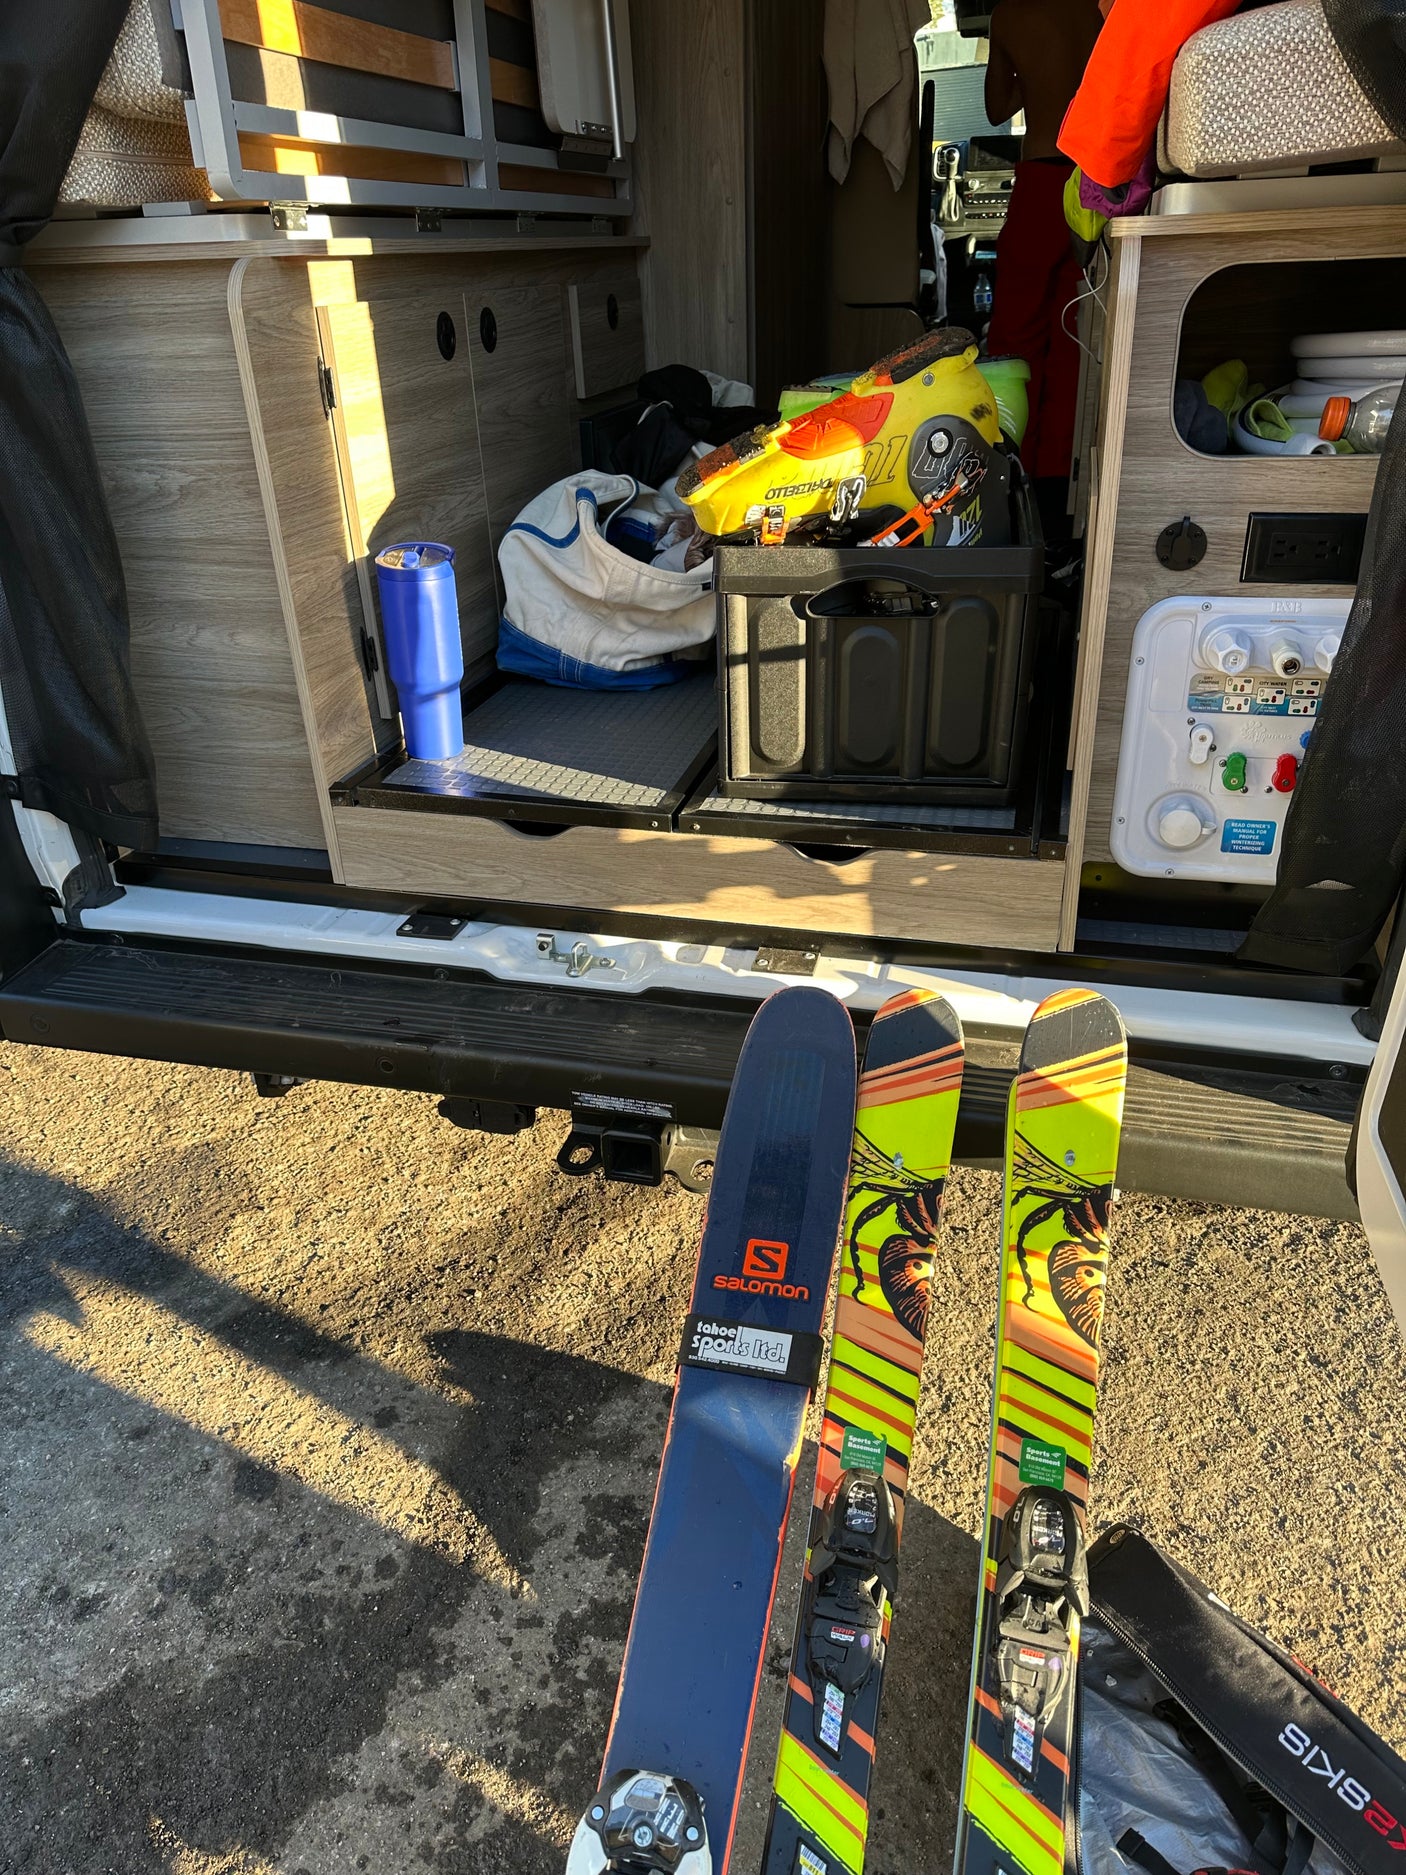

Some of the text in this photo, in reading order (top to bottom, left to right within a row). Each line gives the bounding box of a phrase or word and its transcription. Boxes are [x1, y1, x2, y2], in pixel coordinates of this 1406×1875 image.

[764, 477, 833, 500] DALBELLO
[696, 1320, 737, 1338] tahoe
[691, 1326, 785, 1364] sports ltd.
[848, 1435, 871, 1445] Sports
[847, 1441, 880, 1454] Basement
[1026, 1446, 1050, 1457] Sports
[1025, 1453, 1060, 1466] Basement
[847, 1507, 876, 1518] MARKER
[831, 1626, 857, 1636] GRIP
[831, 1632, 855, 1642] WALK
[1020, 1648, 1046, 1659] GRIP
